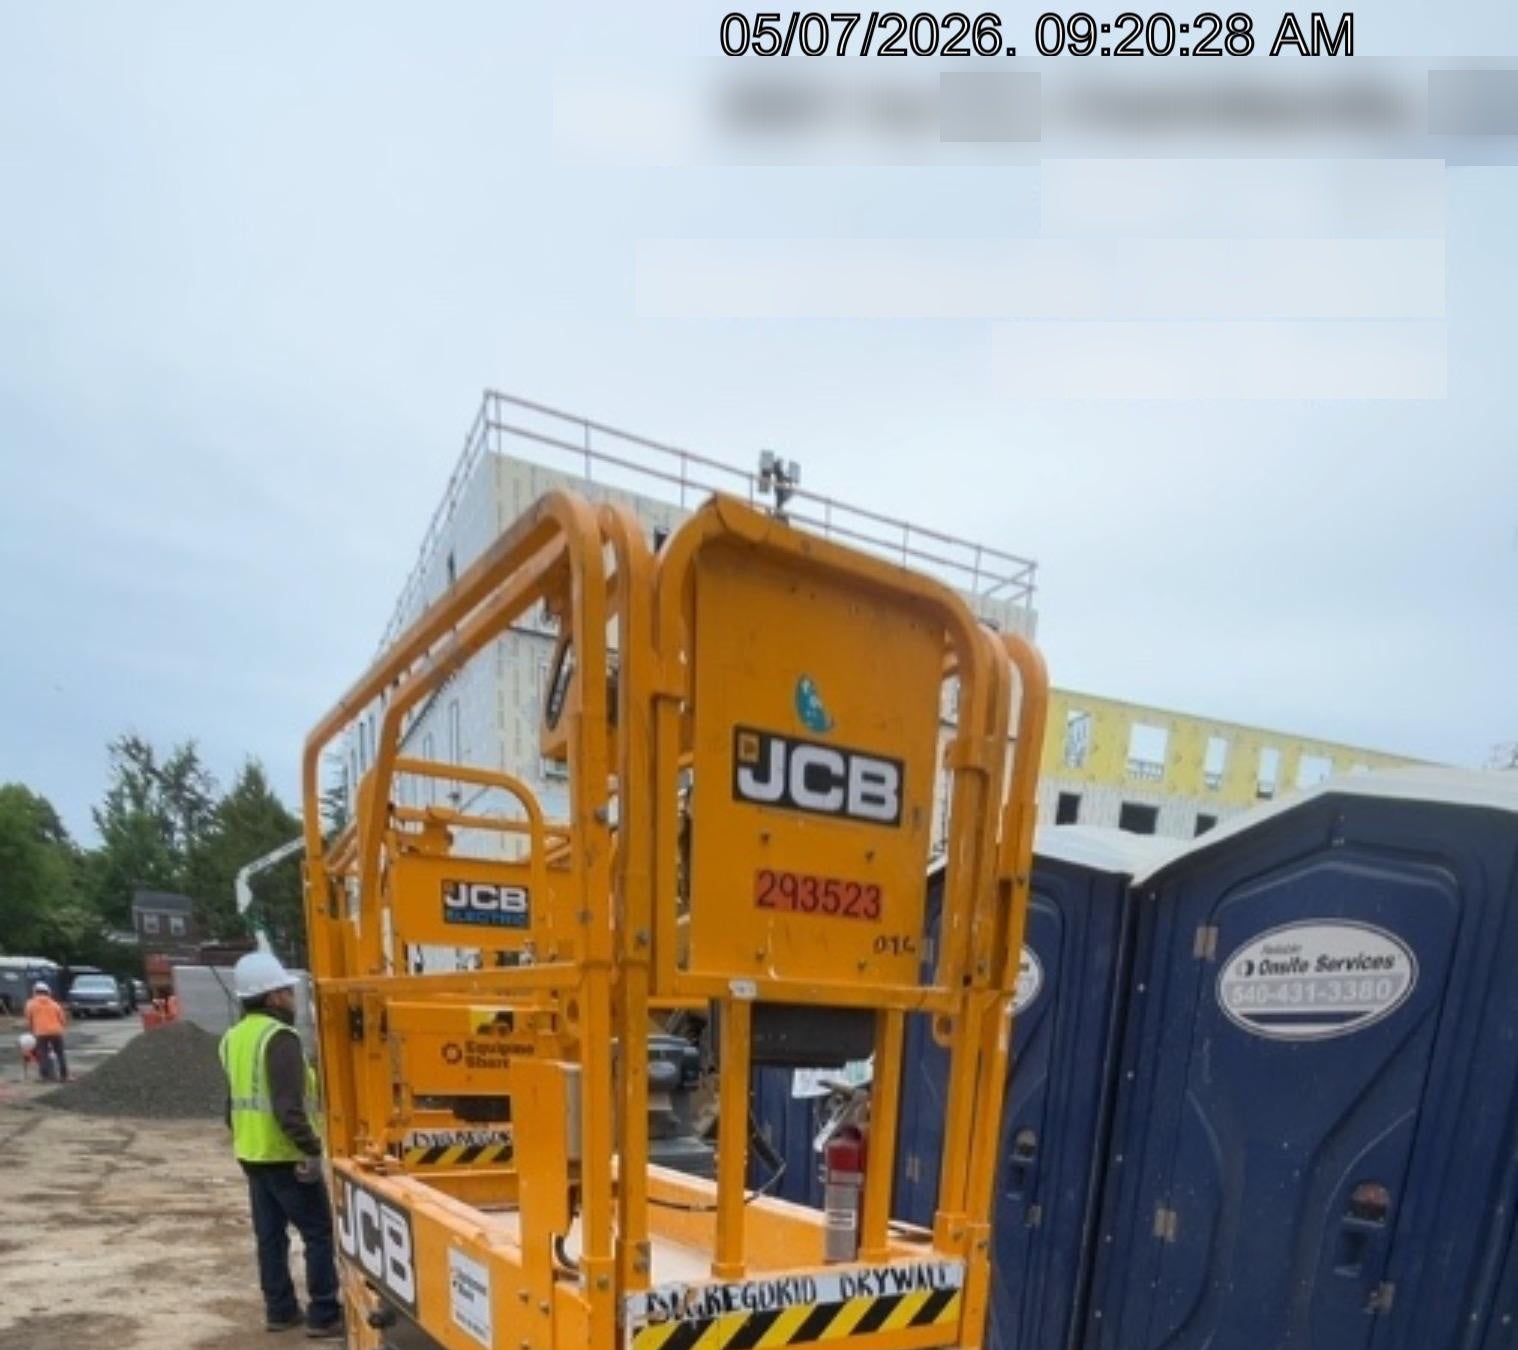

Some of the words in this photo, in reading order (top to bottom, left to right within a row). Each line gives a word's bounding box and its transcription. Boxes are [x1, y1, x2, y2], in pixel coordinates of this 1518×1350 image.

[738, 740, 898, 821] JCB
[444, 883, 527, 912] JCB
[758, 869, 881, 920] 293523
[1260, 956, 1308, 976] Onsite
[1314, 953, 1395, 974] Services
[338, 1181, 415, 1304] JCB
